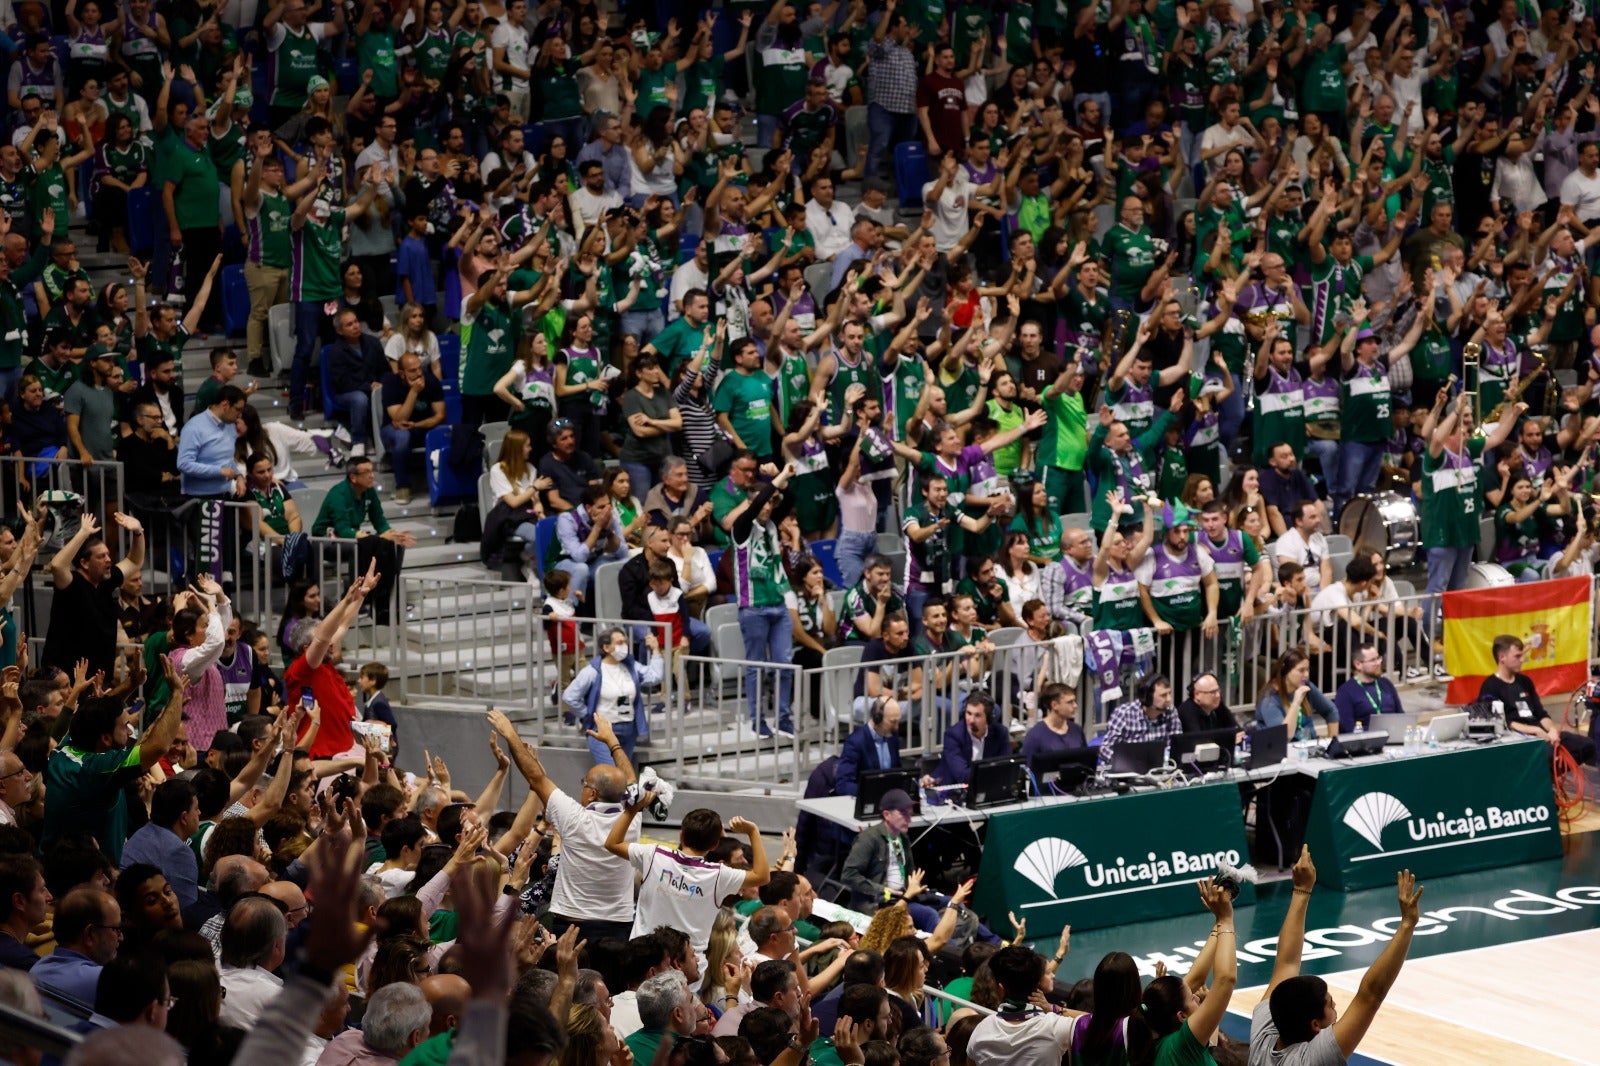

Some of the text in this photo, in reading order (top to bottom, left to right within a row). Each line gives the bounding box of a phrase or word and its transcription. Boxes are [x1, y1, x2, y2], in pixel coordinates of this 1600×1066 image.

[1037, 369, 1045, 381] H
[1376, 403, 1390, 419] 25
[1463, 497, 1475, 514] 25
[1407, 805, 1549, 841] Unicaja Banco
[1083, 849, 1240, 888] Unicaja Banco
[659, 868, 704, 898] Málaga
